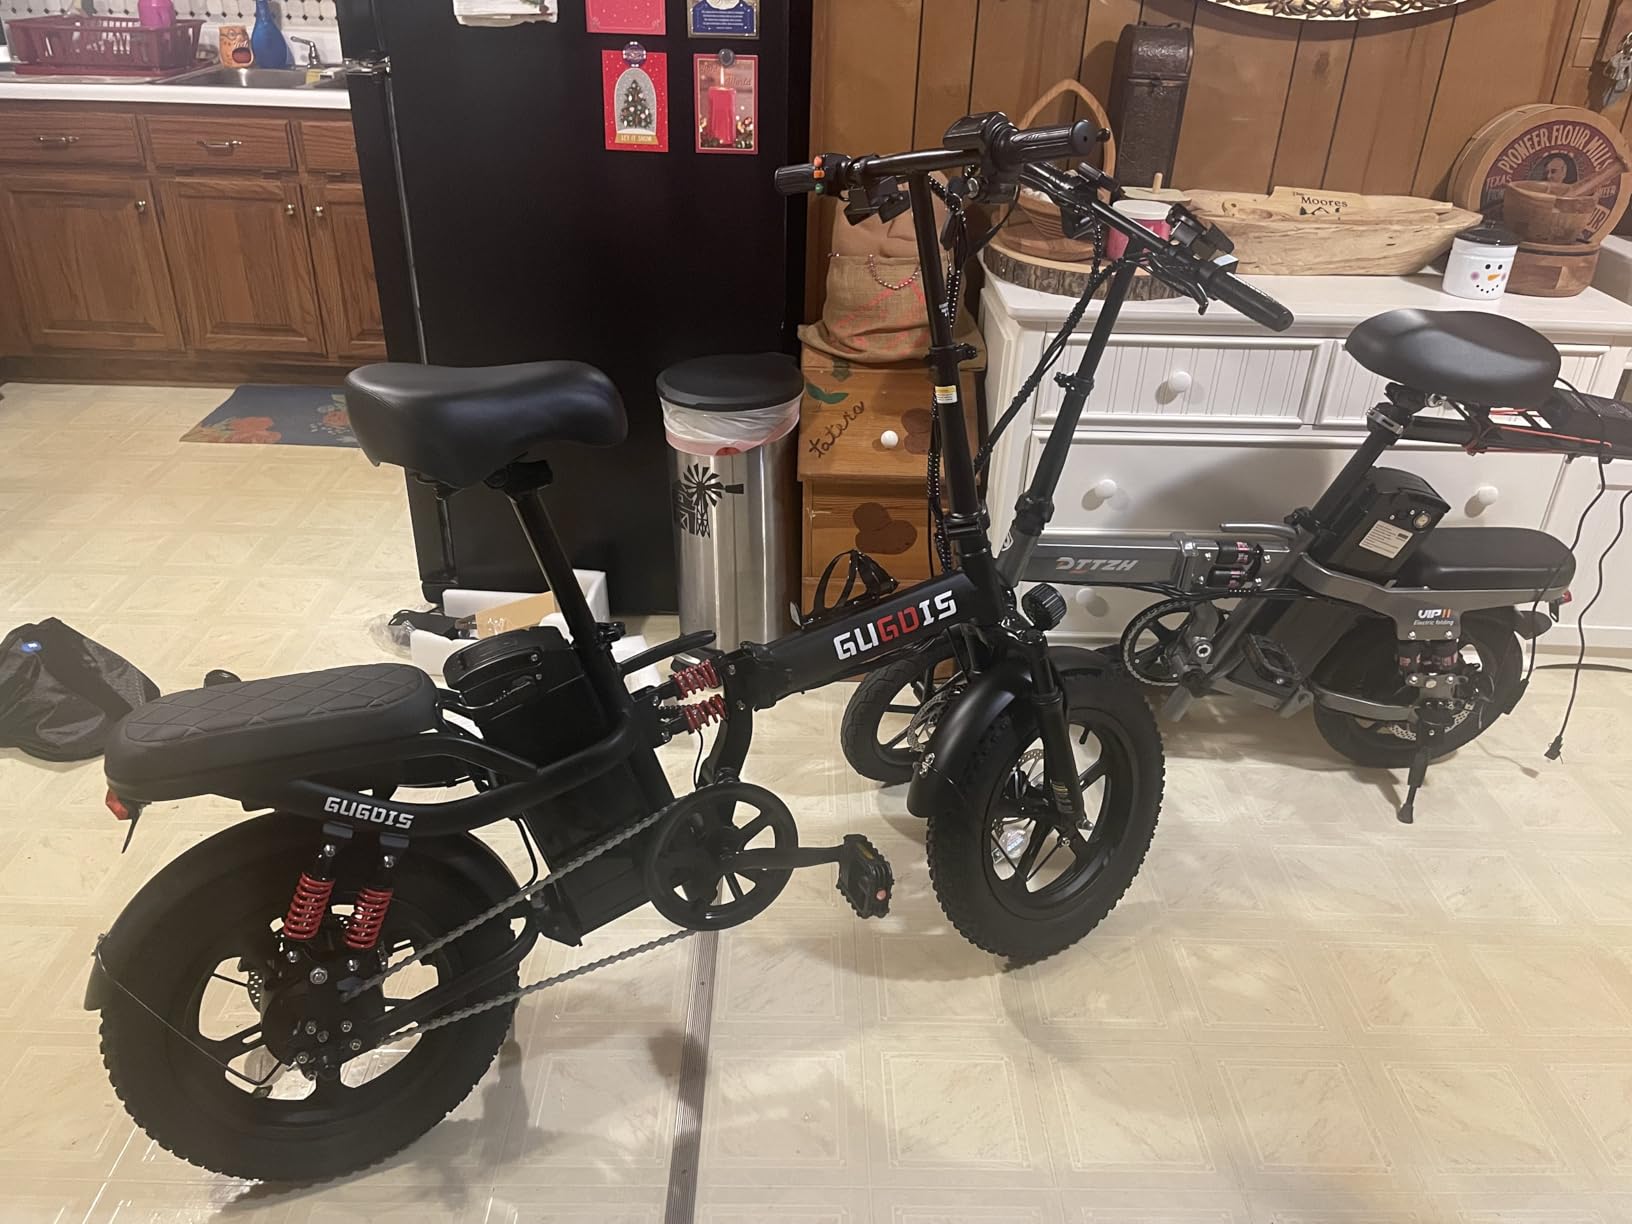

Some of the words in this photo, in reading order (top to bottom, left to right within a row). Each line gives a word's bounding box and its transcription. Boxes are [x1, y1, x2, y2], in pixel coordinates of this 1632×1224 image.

[1498, 128, 1550, 174] PIONEER
[1551, 125, 1591, 150] FLOUR
[1583, 136, 1613, 171] MILLS
[1486, 174, 1512, 192] TEXAS
[1301, 196, 1348, 208] Moores
